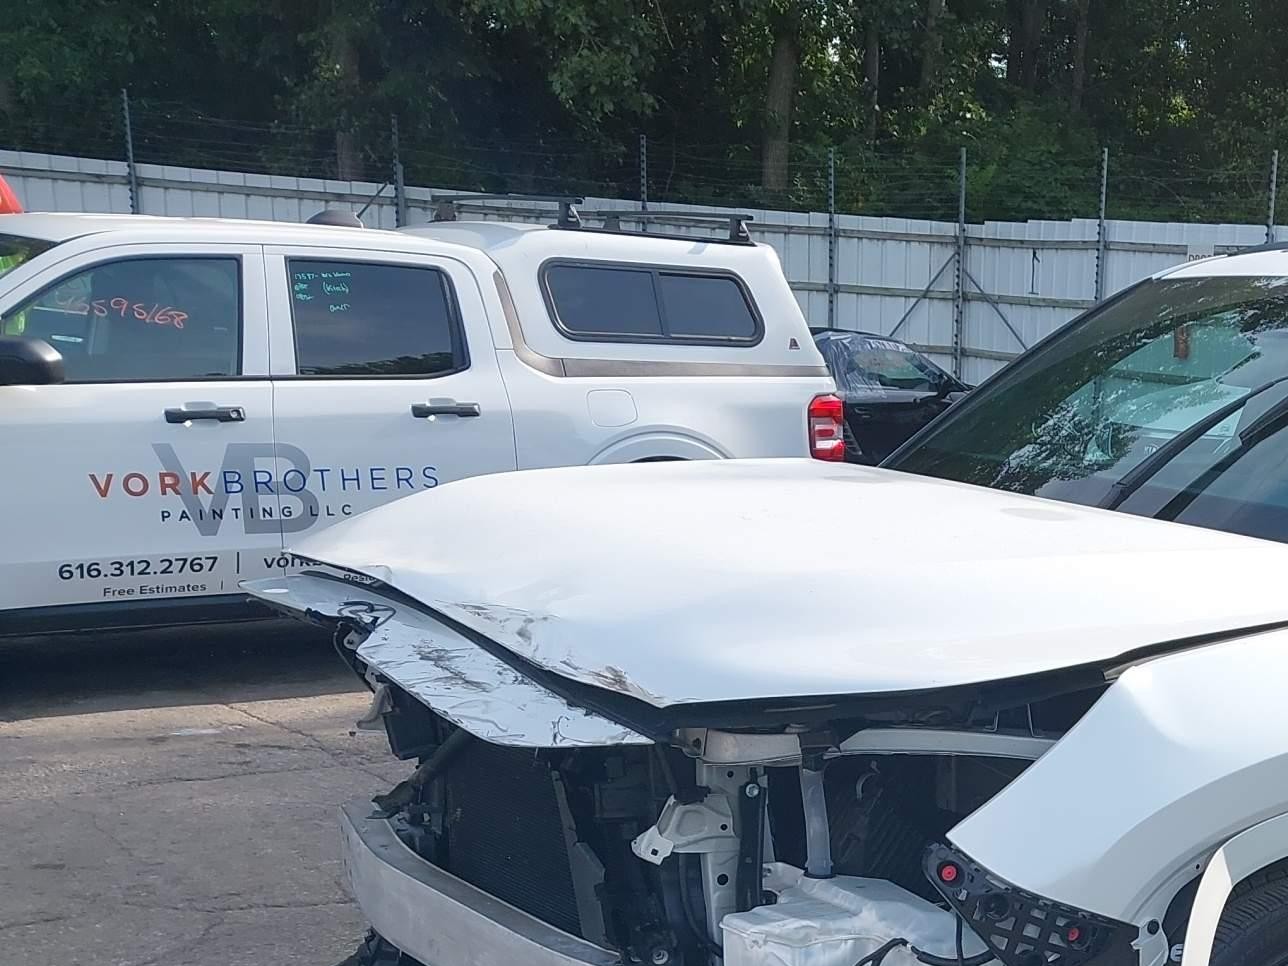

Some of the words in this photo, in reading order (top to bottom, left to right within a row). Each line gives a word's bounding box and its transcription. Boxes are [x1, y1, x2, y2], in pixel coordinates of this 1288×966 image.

[152, 443, 319, 536] VB
[161, 505, 293, 522] PAINTING
[310, 504, 353, 518] LLC
[58, 556, 218, 580] 616.312.2767
[103, 587, 135, 597] Free
[140, 583, 207, 595] Estimates
